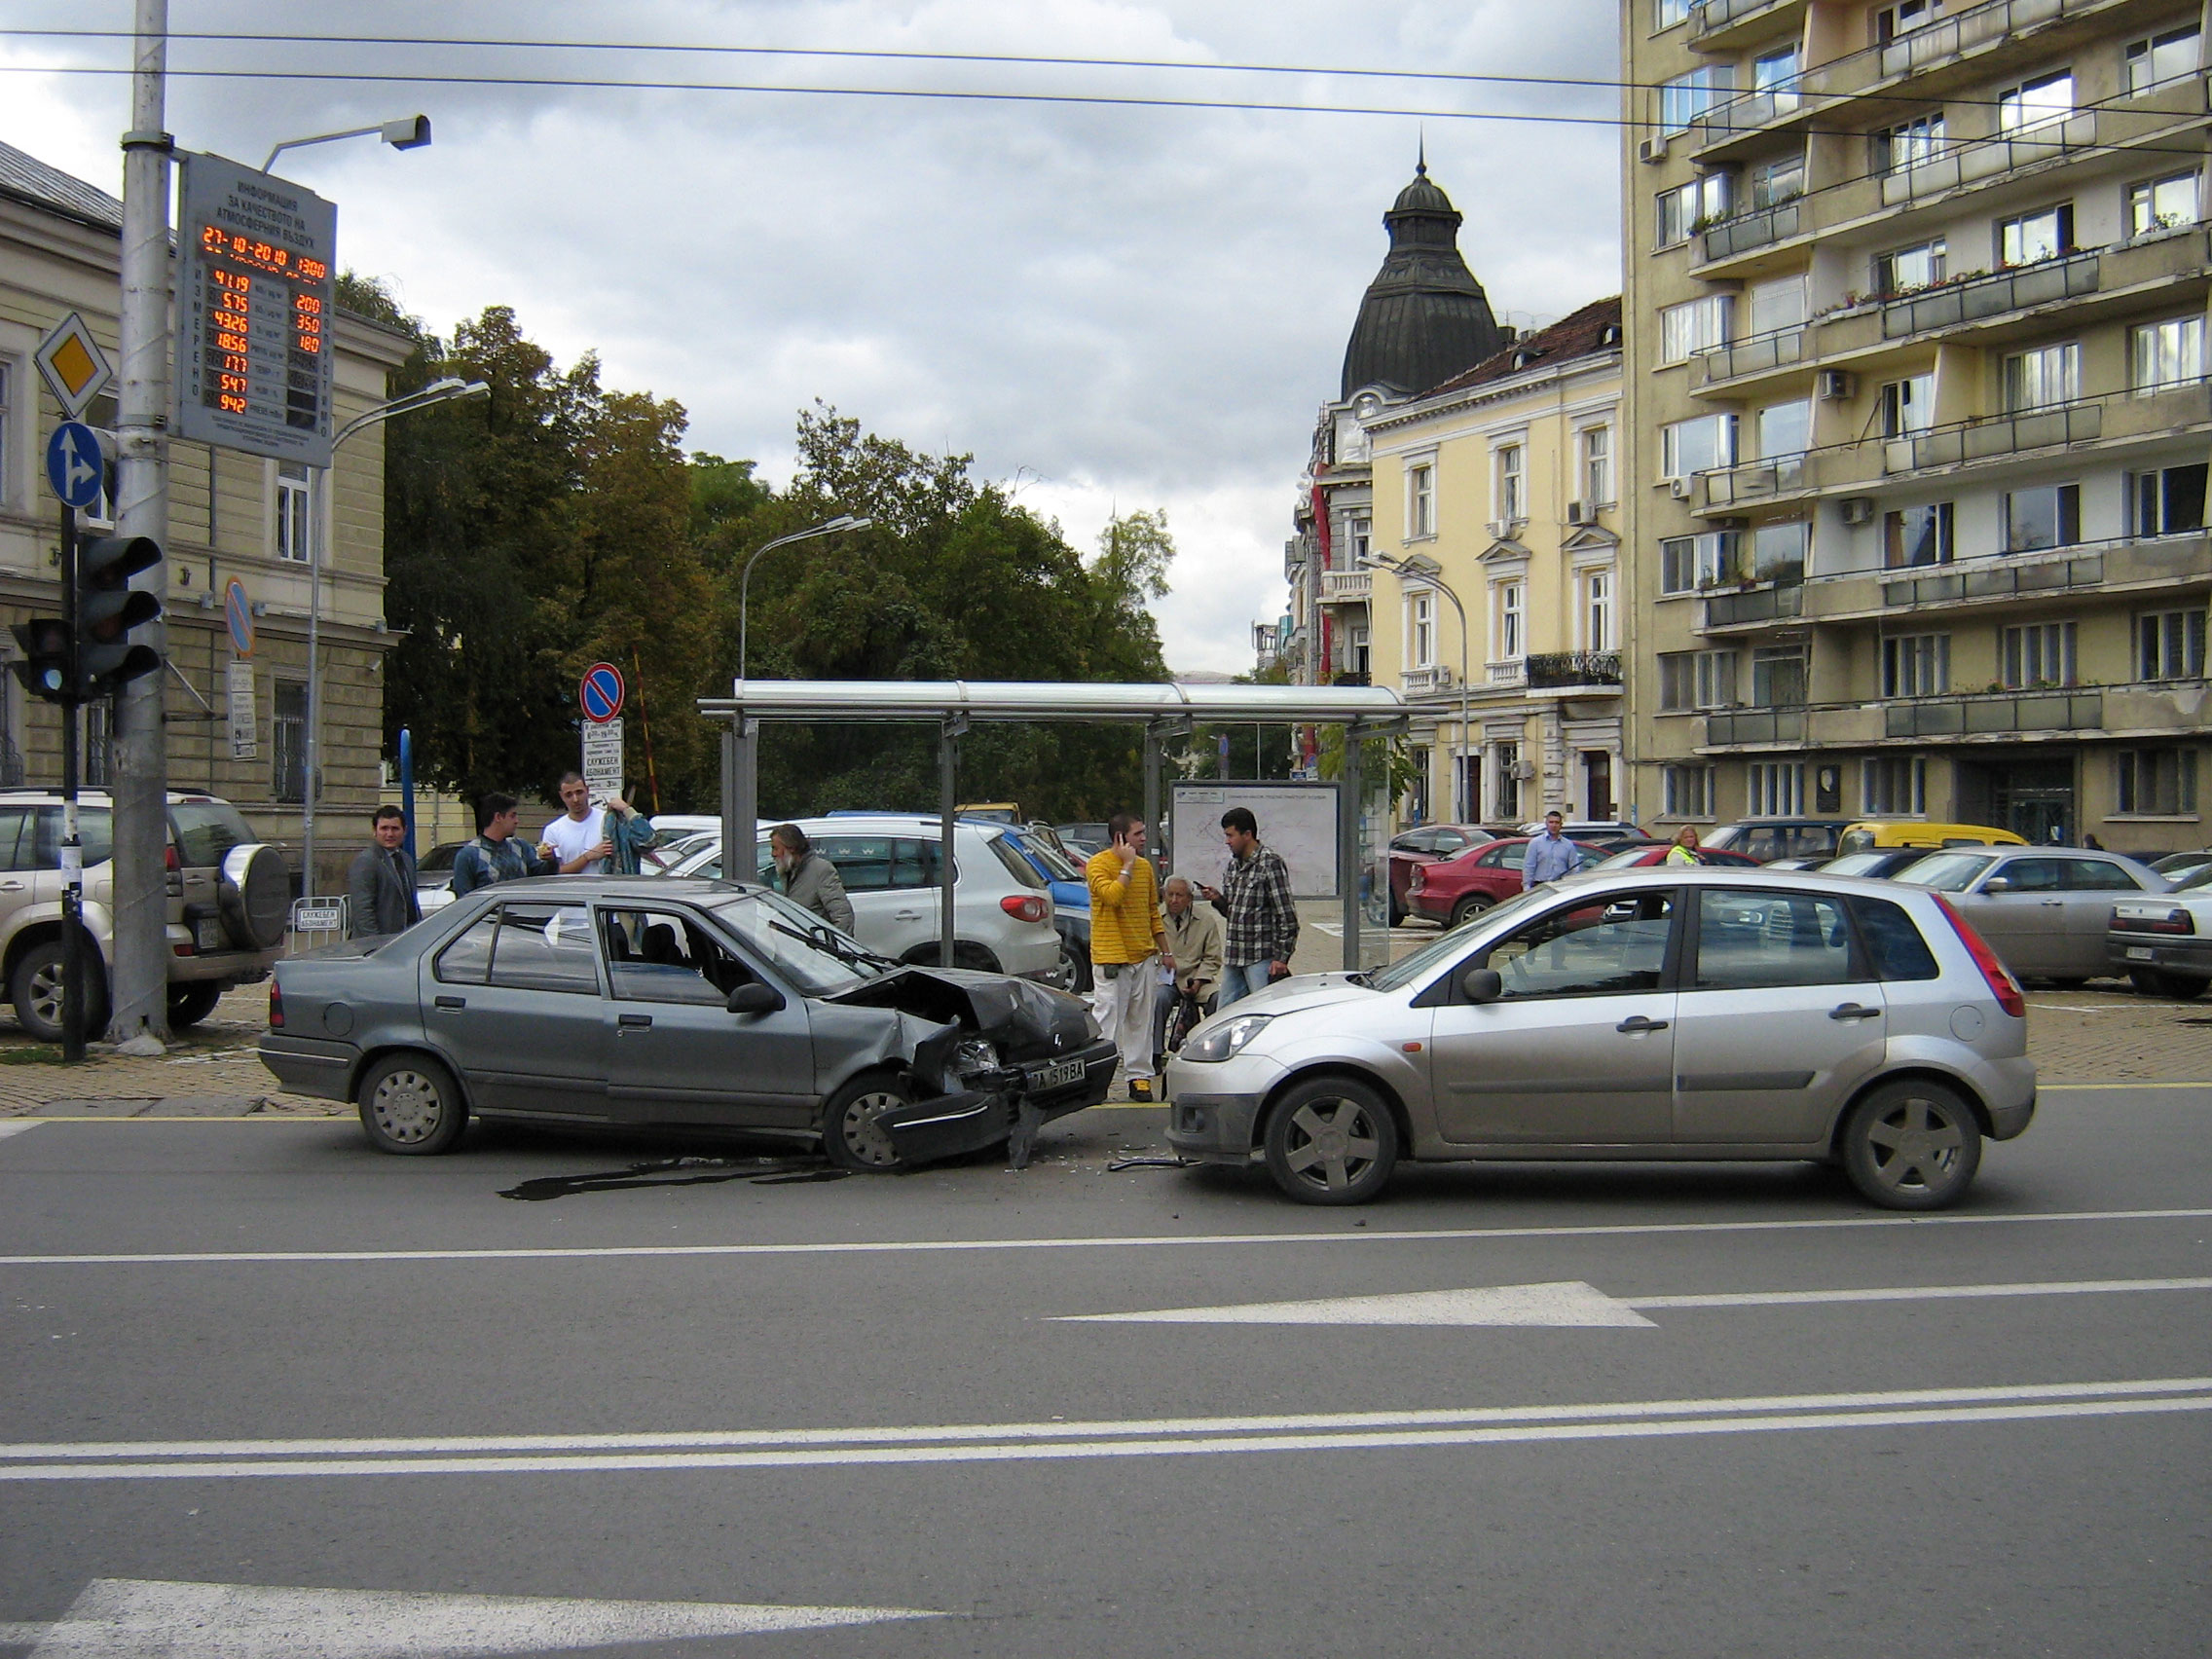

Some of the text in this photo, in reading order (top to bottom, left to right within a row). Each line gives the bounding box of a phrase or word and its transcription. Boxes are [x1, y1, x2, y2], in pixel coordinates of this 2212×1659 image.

[238, 181, 298, 211] ИНФОРМАЦИЯ
[217, 206, 281, 236] АТМОСФЕРНИЯ
[228, 195, 306, 231] ЗА КАЧЕСТВОТО НА
[295, 294, 321, 314] 200
[296, 313, 321, 334] 350
[299, 335, 321, 353] 180
[219, 393, 247, 415] 942
[586, 766, 620, 776] АБОНАМЕНТ
[587, 756, 618, 766] СЛУЖЕБЕН
